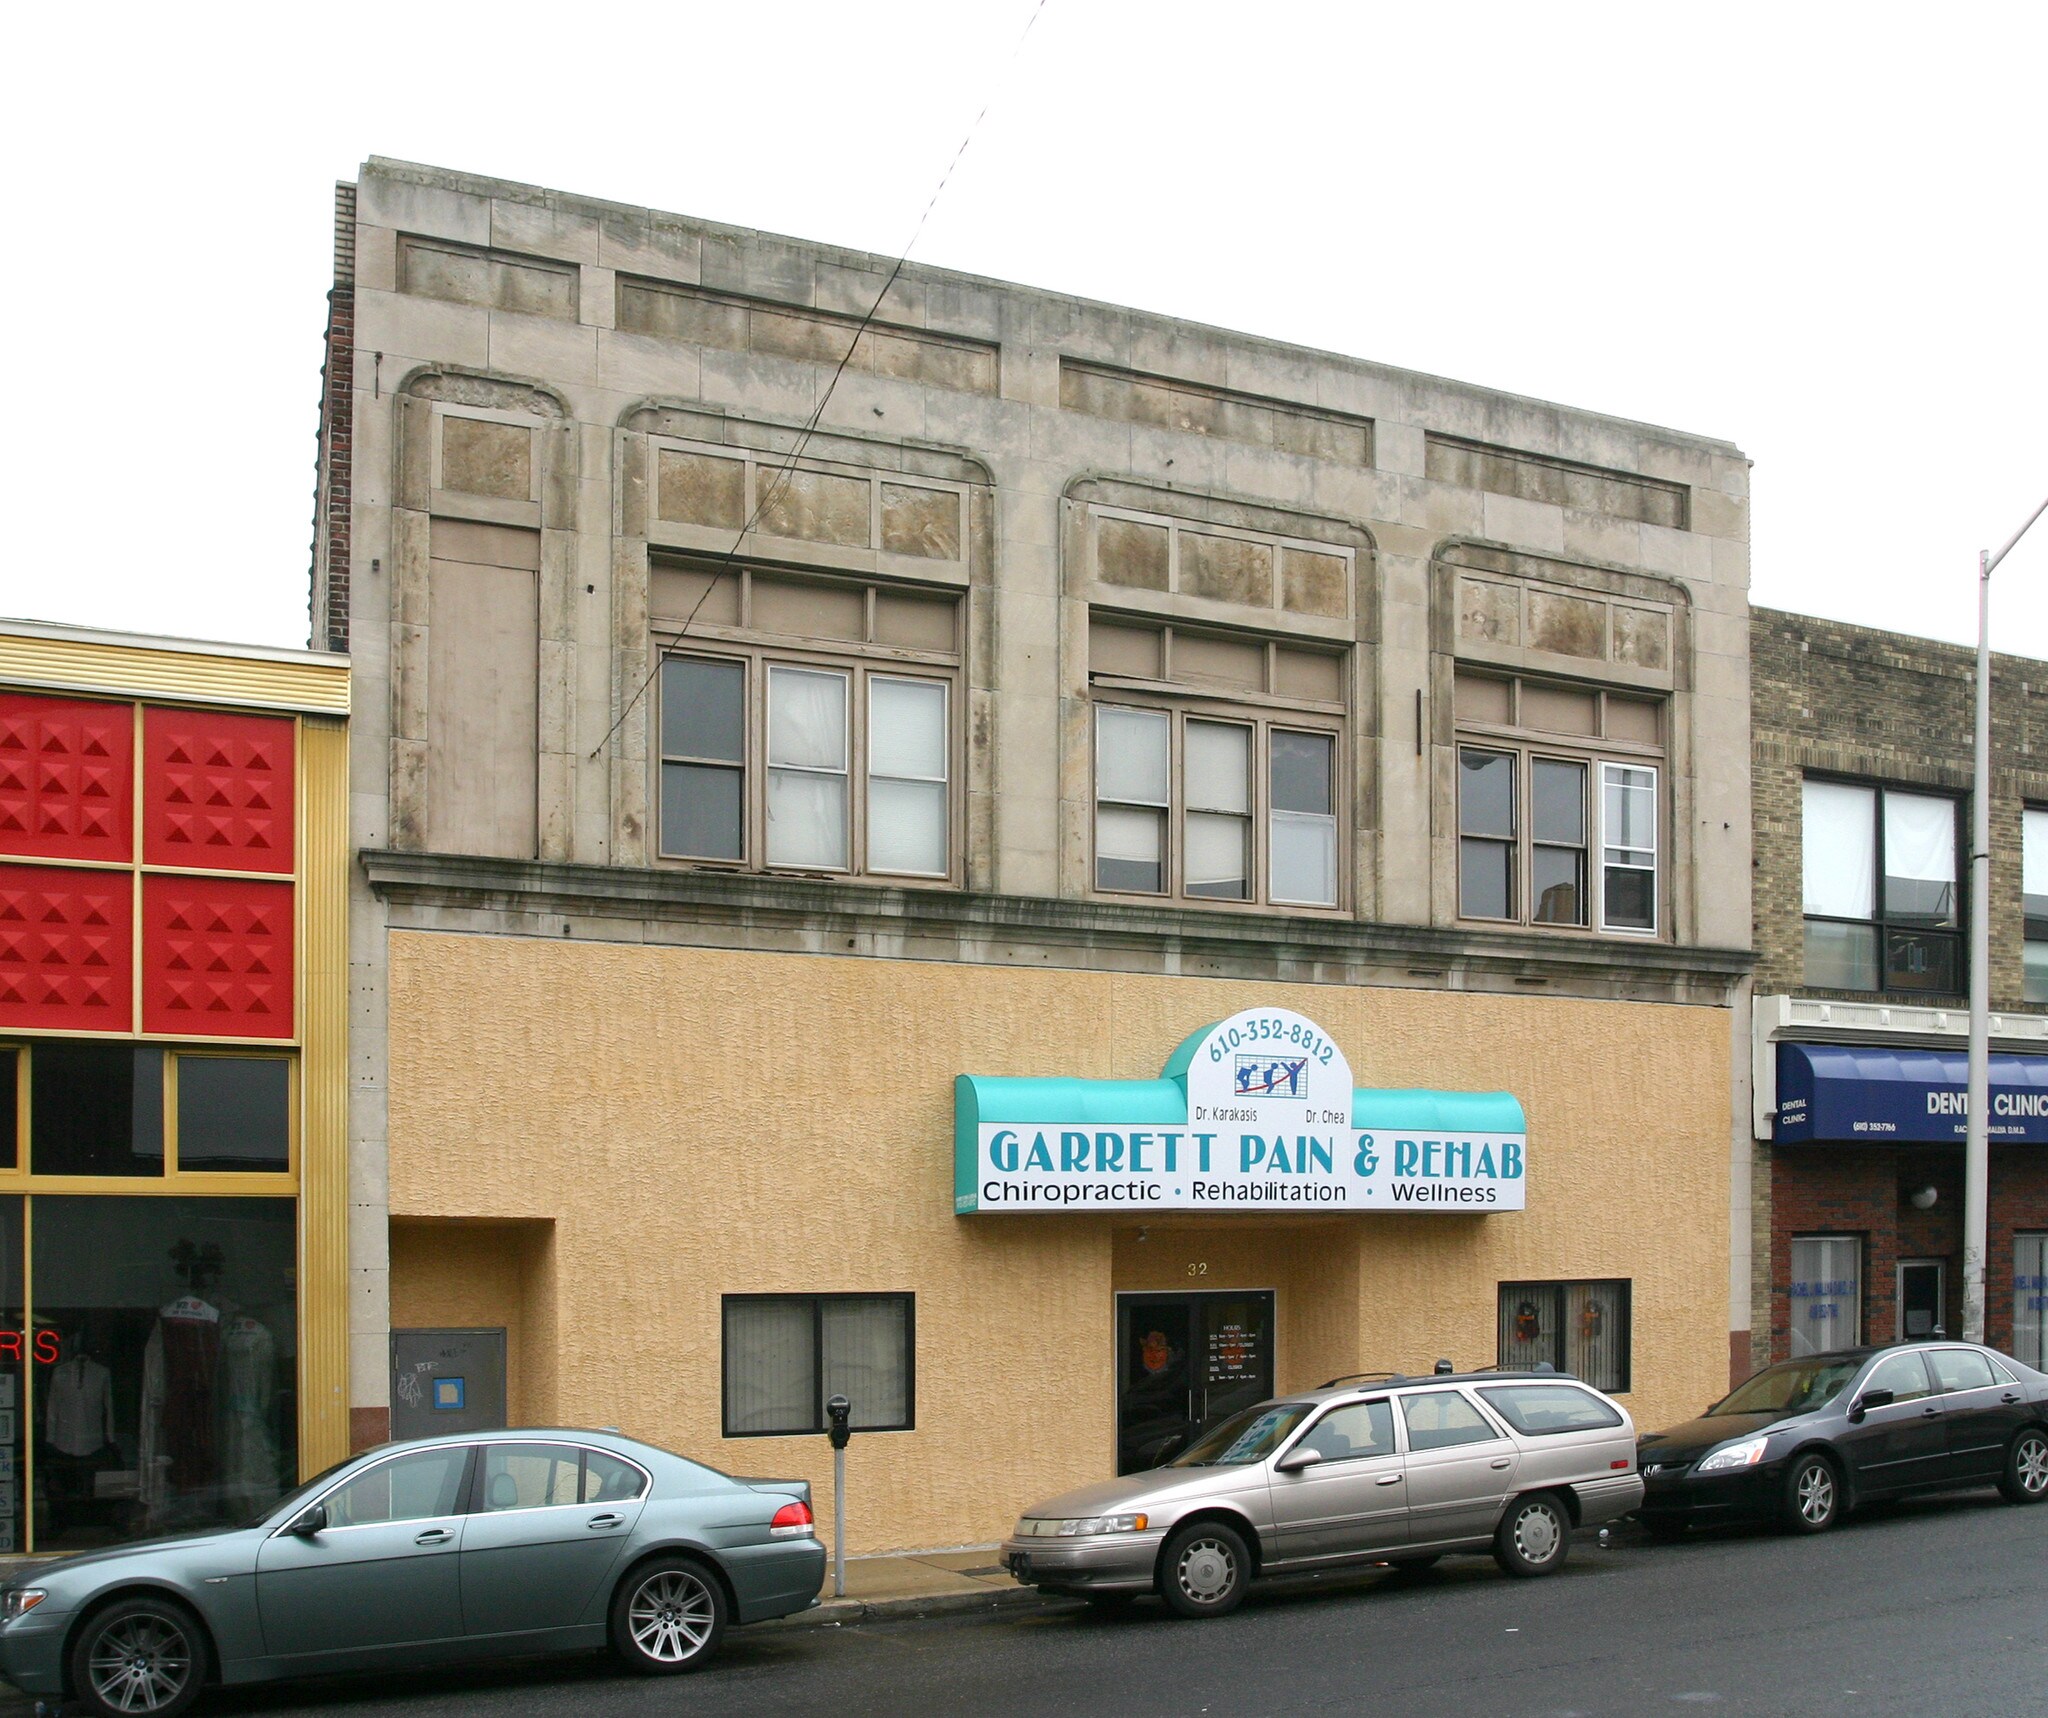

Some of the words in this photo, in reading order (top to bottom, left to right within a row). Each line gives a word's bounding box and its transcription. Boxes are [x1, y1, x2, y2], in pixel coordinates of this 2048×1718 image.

[1210, 1019, 1333, 1066] 610-352-8812
[1782, 1098, 1807, 1111] DENTAL
[1927, 1092, 1990, 1114] DENT
[1196, 1106, 1210, 1121] Dr.
[1212, 1107, 1257, 1122] Karakasis
[1306, 1110, 1319, 1123] Dr.
[1322, 1110, 1345, 1124] Chea
[1782, 1113, 1806, 1125] CLINIC
[990, 1130, 1217, 1173] GARRETT
[1240, 1134, 1333, 1174] PAIN
[1354, 1134, 1380, 1177] &
[1394, 1140, 1523, 1179] REHAB
[983, 1181, 1161, 1204] Chiropractic
[1193, 1181, 1346, 1201] Rehabilitation
[1391, 1183, 1497, 1202] Wellness
[1188, 1262, 1208, 1277] 32
